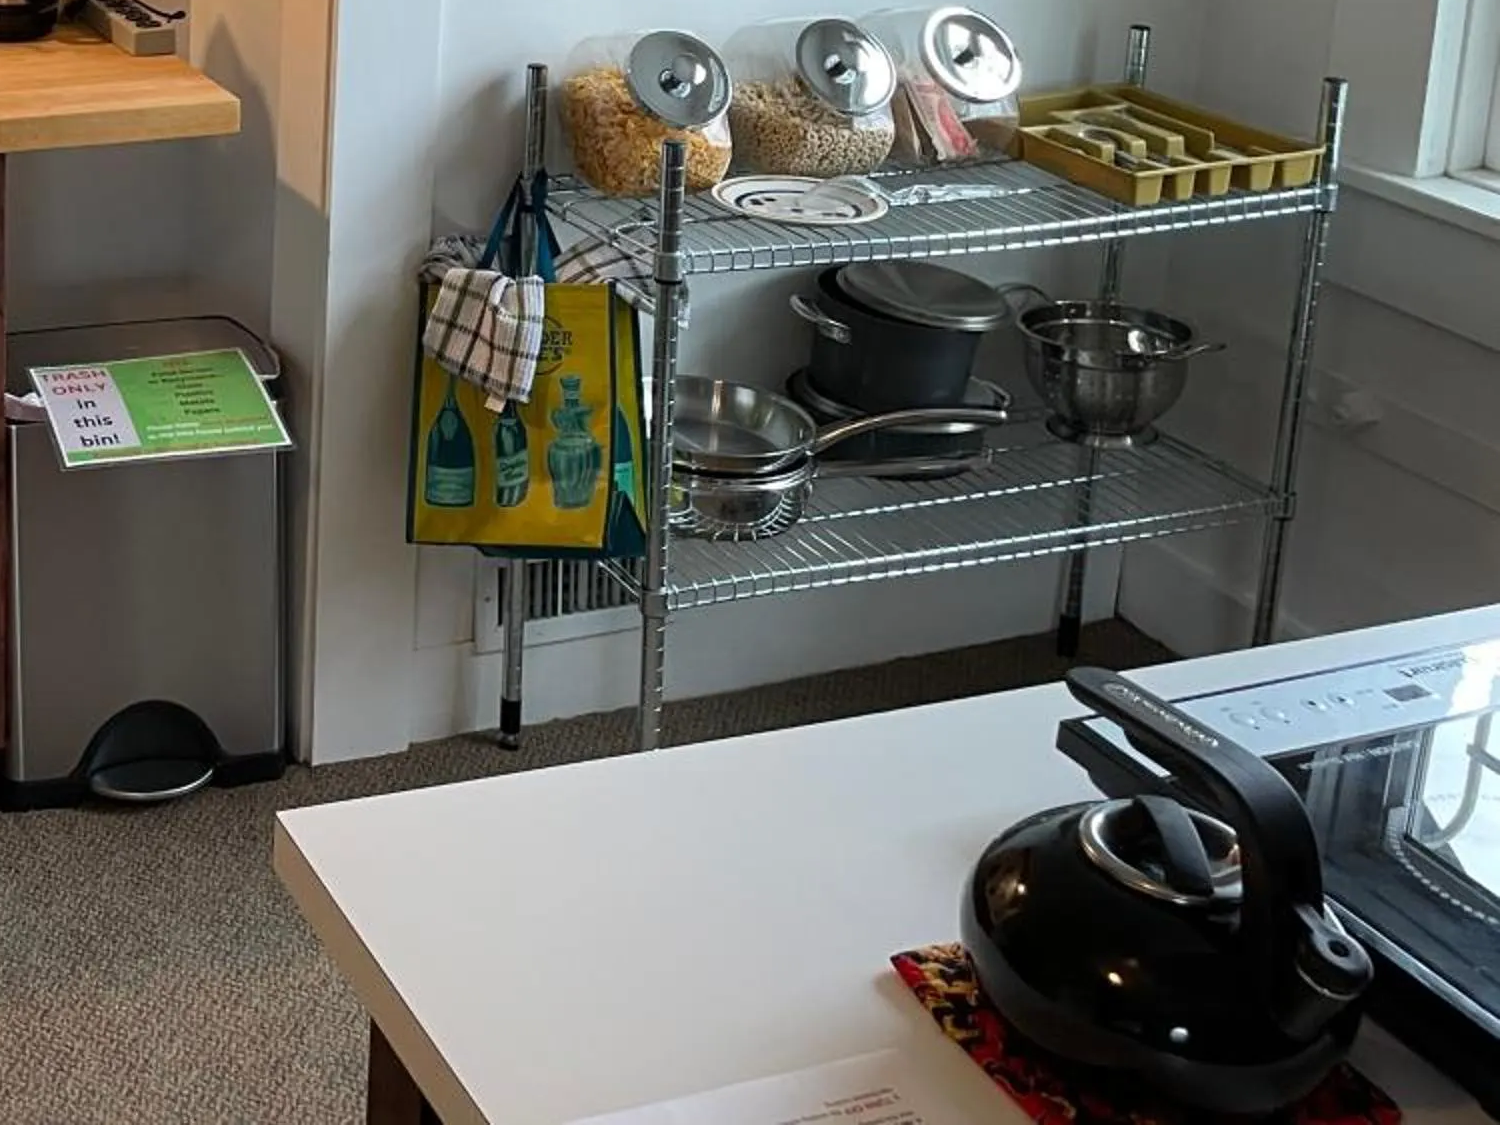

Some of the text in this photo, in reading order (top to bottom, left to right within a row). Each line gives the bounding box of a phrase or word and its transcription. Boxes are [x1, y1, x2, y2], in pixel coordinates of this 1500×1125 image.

[42, 369, 107, 383] TRASH
[51, 382, 107, 396] ONLY
[76, 398, 97, 410] in
[73, 415, 113, 428] this
[80, 433, 121, 447] bin!
